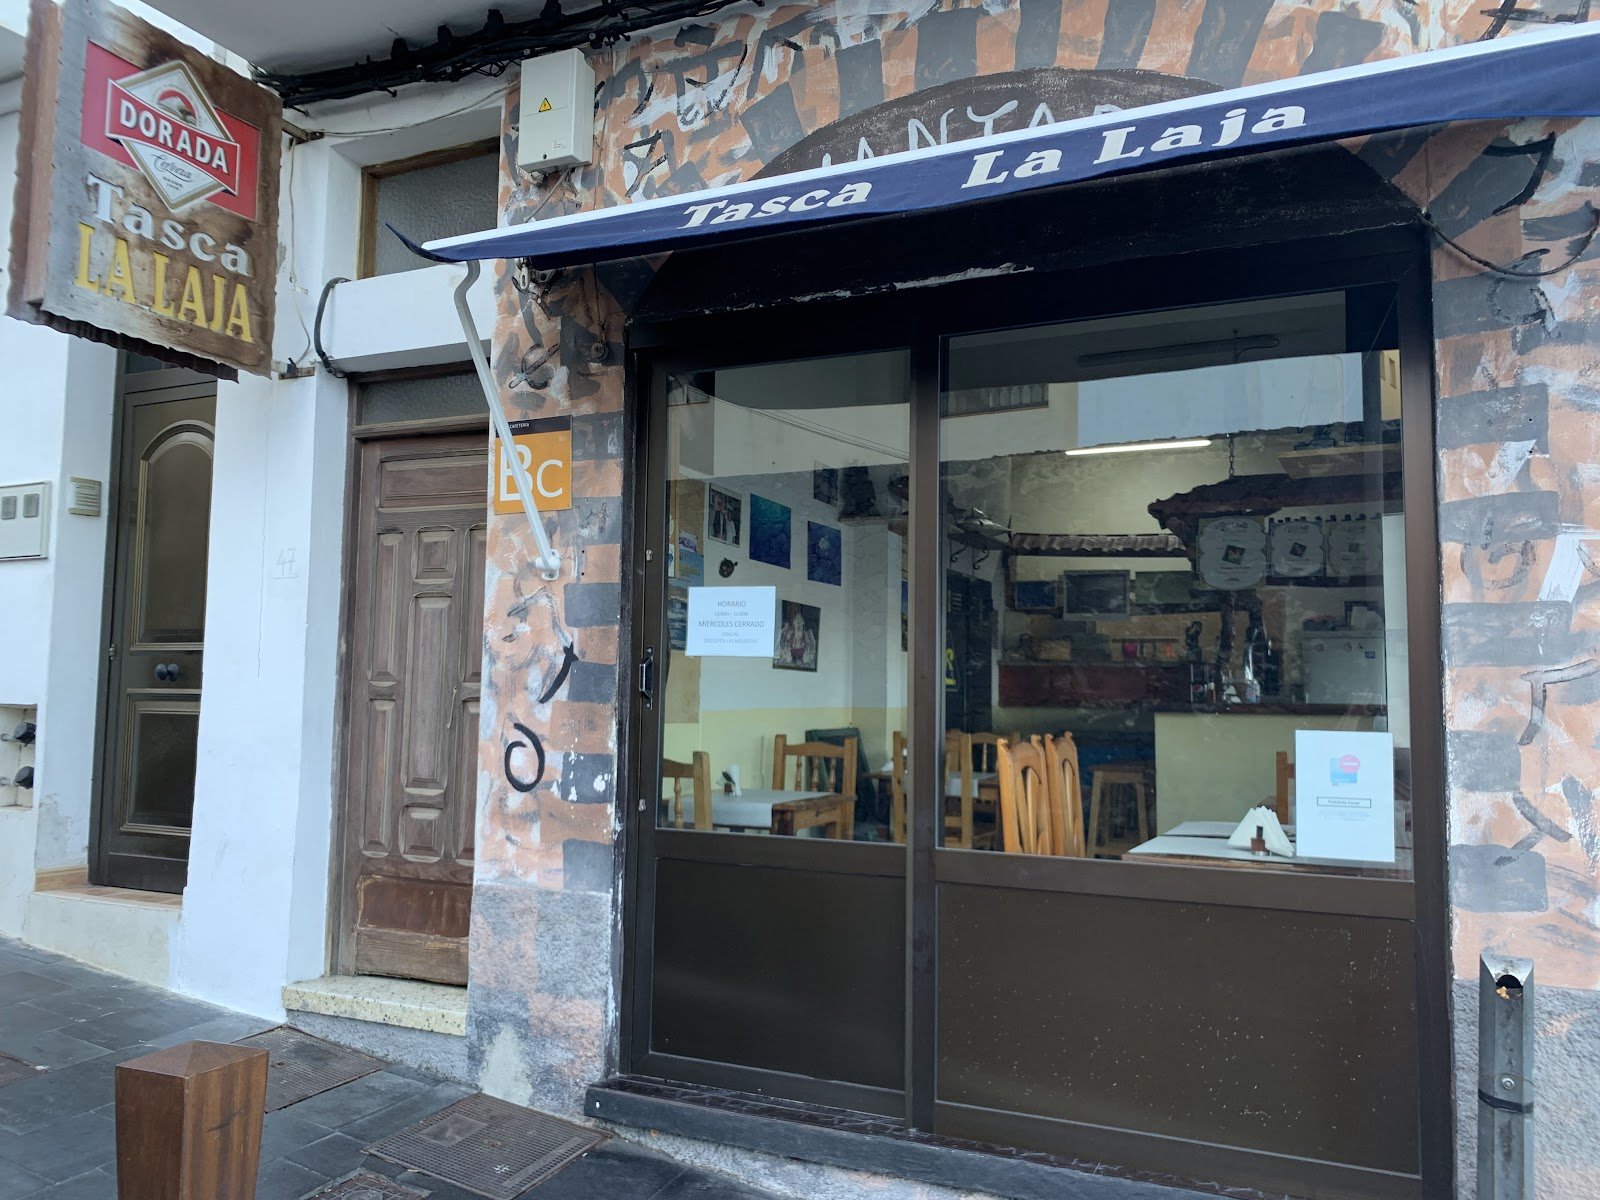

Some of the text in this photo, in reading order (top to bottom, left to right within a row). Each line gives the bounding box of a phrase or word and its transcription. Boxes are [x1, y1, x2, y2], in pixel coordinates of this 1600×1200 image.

[119, 98, 229, 175] DORADA
[676, 104, 1308, 230] Tasca La Laja
[85, 172, 253, 277] Tasca
[75, 222, 254, 343] LA LAJA
[698, 620, 765, 628] MIERCOLES CERRADO
[717, 600, 747, 608] HORARIO
